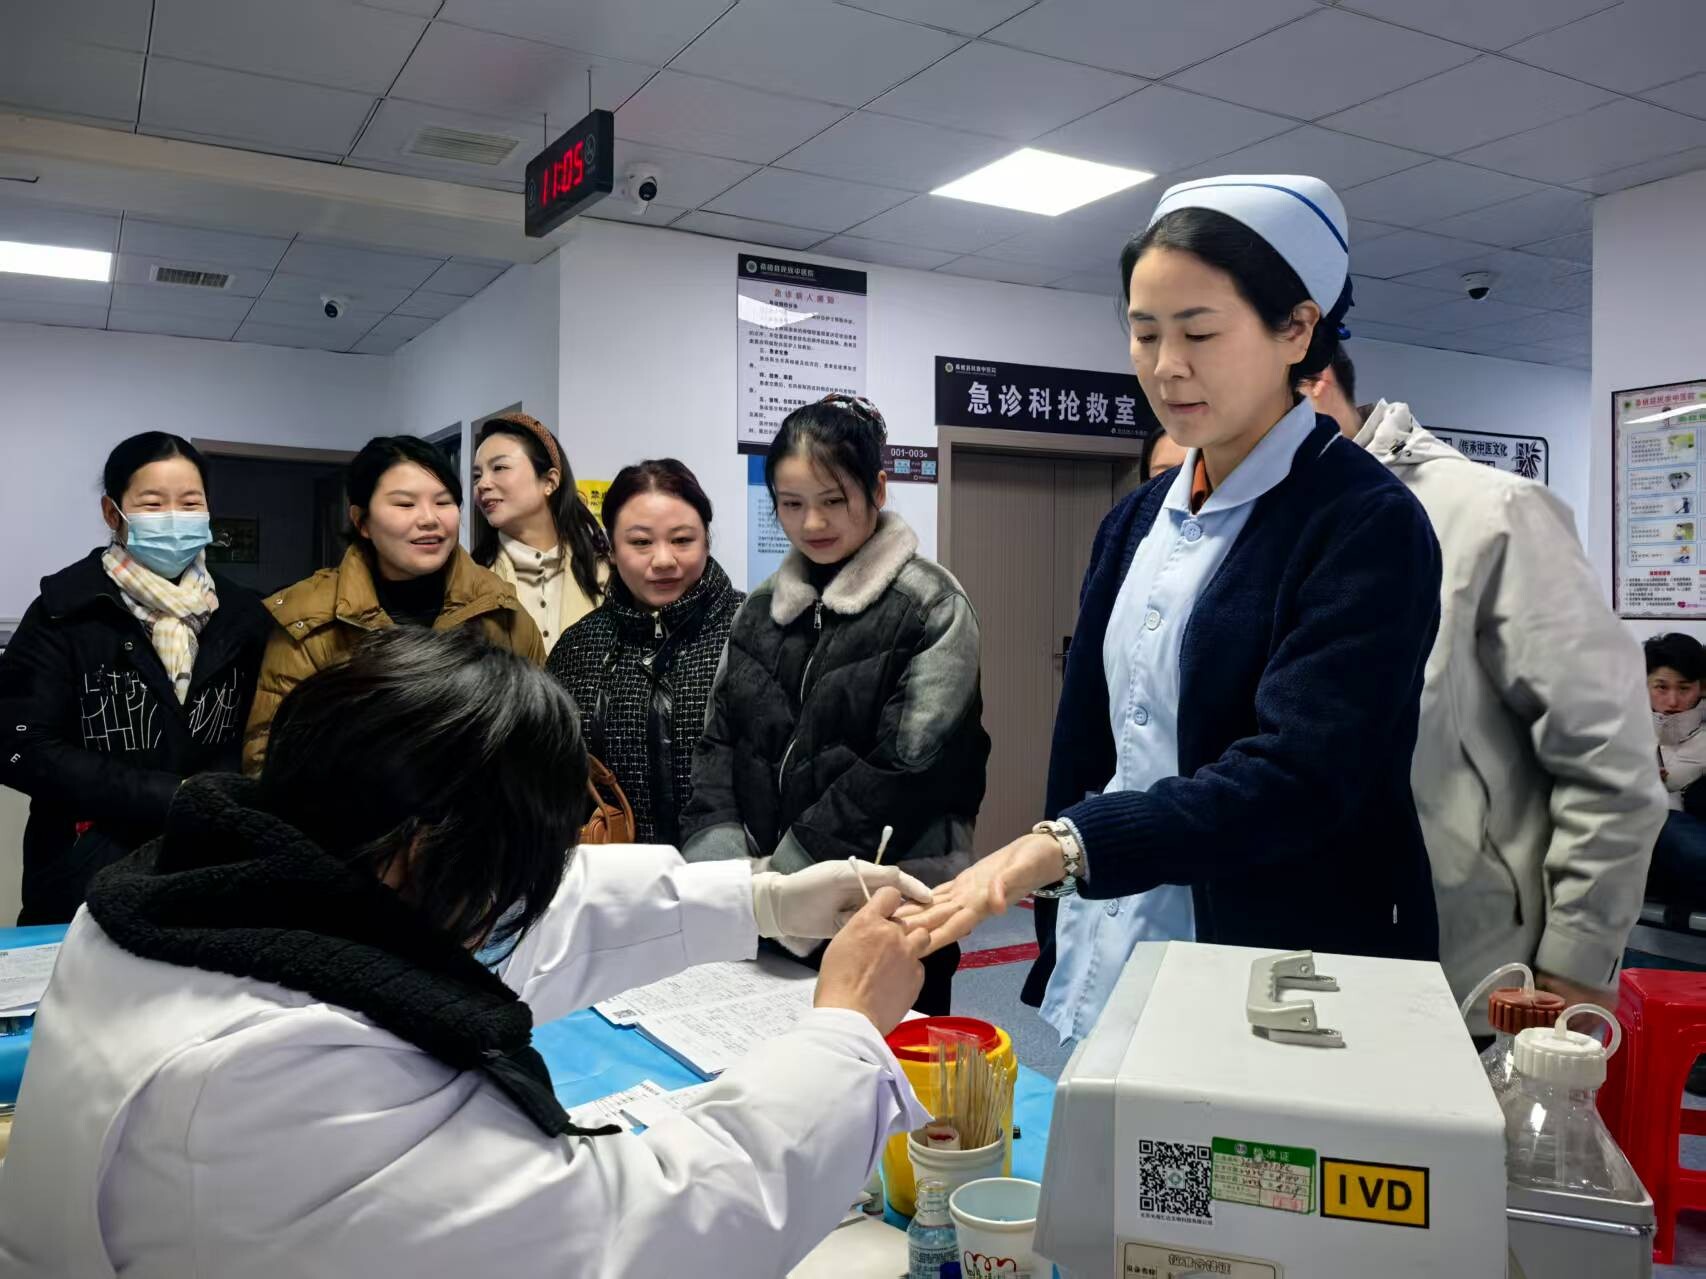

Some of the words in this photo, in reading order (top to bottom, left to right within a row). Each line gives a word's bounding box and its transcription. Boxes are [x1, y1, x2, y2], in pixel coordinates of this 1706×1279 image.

[541, 141, 584, 207] 11:05
[967, 381, 1137, 426] 急诊科抢救室
[1461, 440, 1508, 457] 传承中医文化
[1338, 1174, 1413, 1212] IVD
